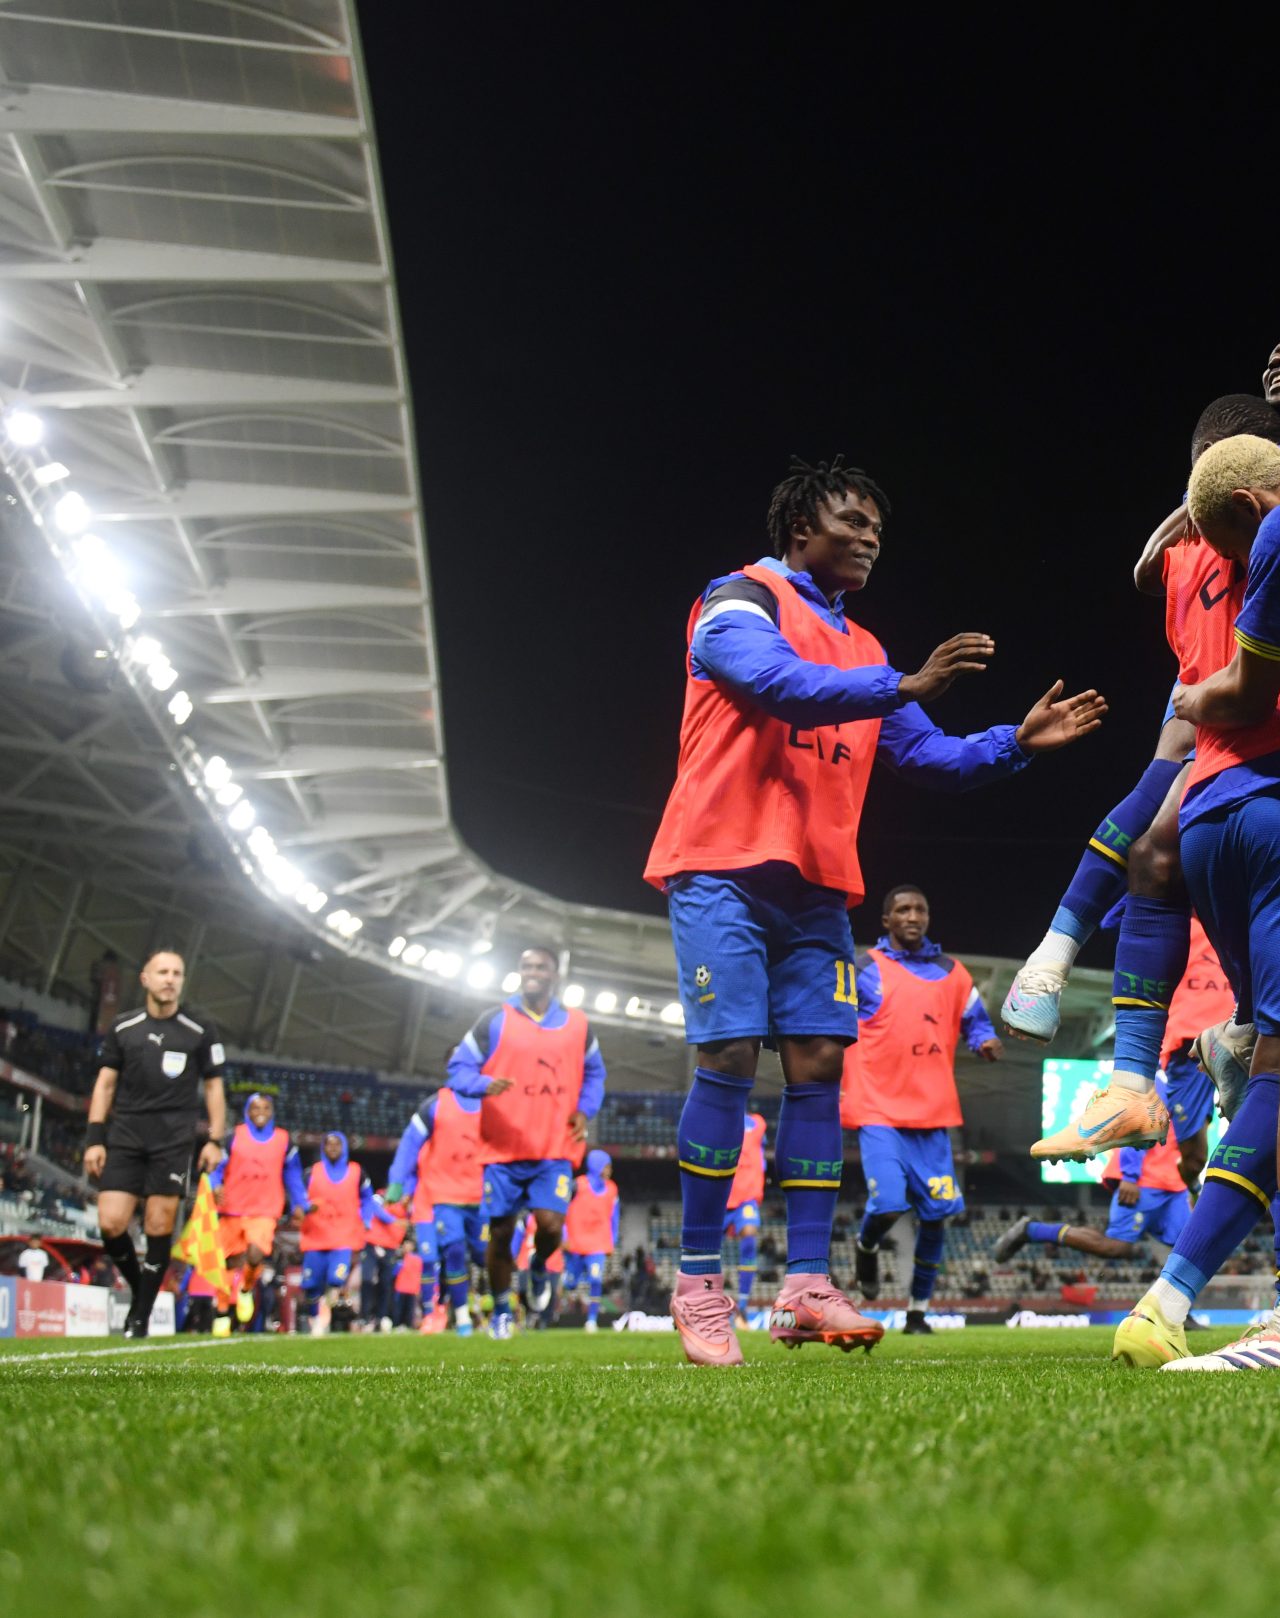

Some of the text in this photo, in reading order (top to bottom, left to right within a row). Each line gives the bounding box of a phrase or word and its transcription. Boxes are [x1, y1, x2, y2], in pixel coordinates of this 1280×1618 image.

[833, 960, 858, 1006] 11
[911, 1042, 943, 1056] CA
[524, 1083, 567, 1097] CAF
[554, 1173, 570, 1199] 5
[927, 1175, 954, 1200] 23
